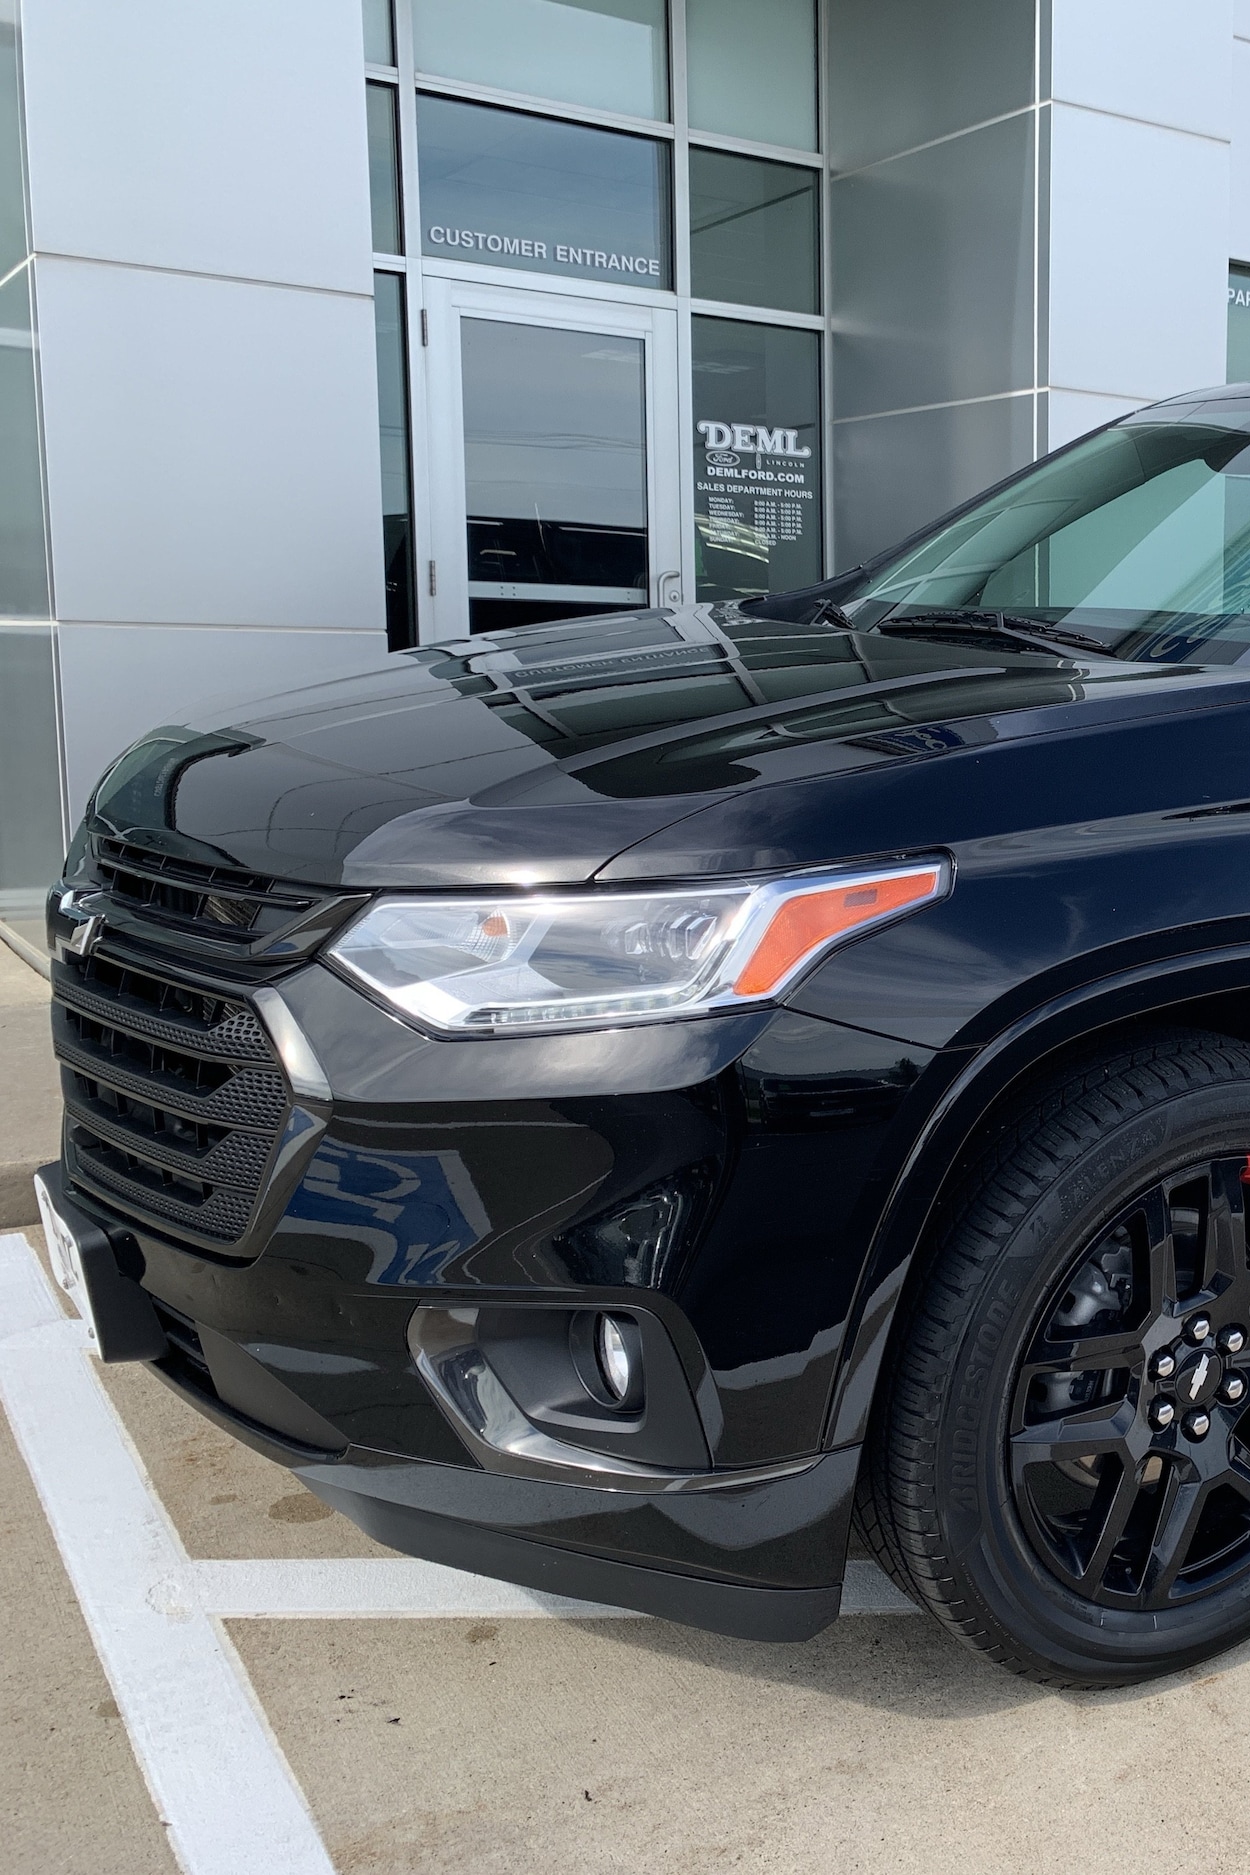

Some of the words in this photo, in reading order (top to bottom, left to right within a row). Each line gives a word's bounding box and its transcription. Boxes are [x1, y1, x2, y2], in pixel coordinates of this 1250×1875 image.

[430, 226, 547, 259] CUSTOMER
[556, 245, 660, 276] ENTRANCE
[697, 420, 811, 458] DEML
[707, 466, 804, 484] DEMLFORD.COM
[766, 459, 805, 468] LINCOLN
[697, 482, 725, 493] SALES
[726, 485, 783, 498] DEPARTMENT
[784, 489, 813, 500] HOURS
[947, 1279, 1019, 1512] BRIDGESTONE
